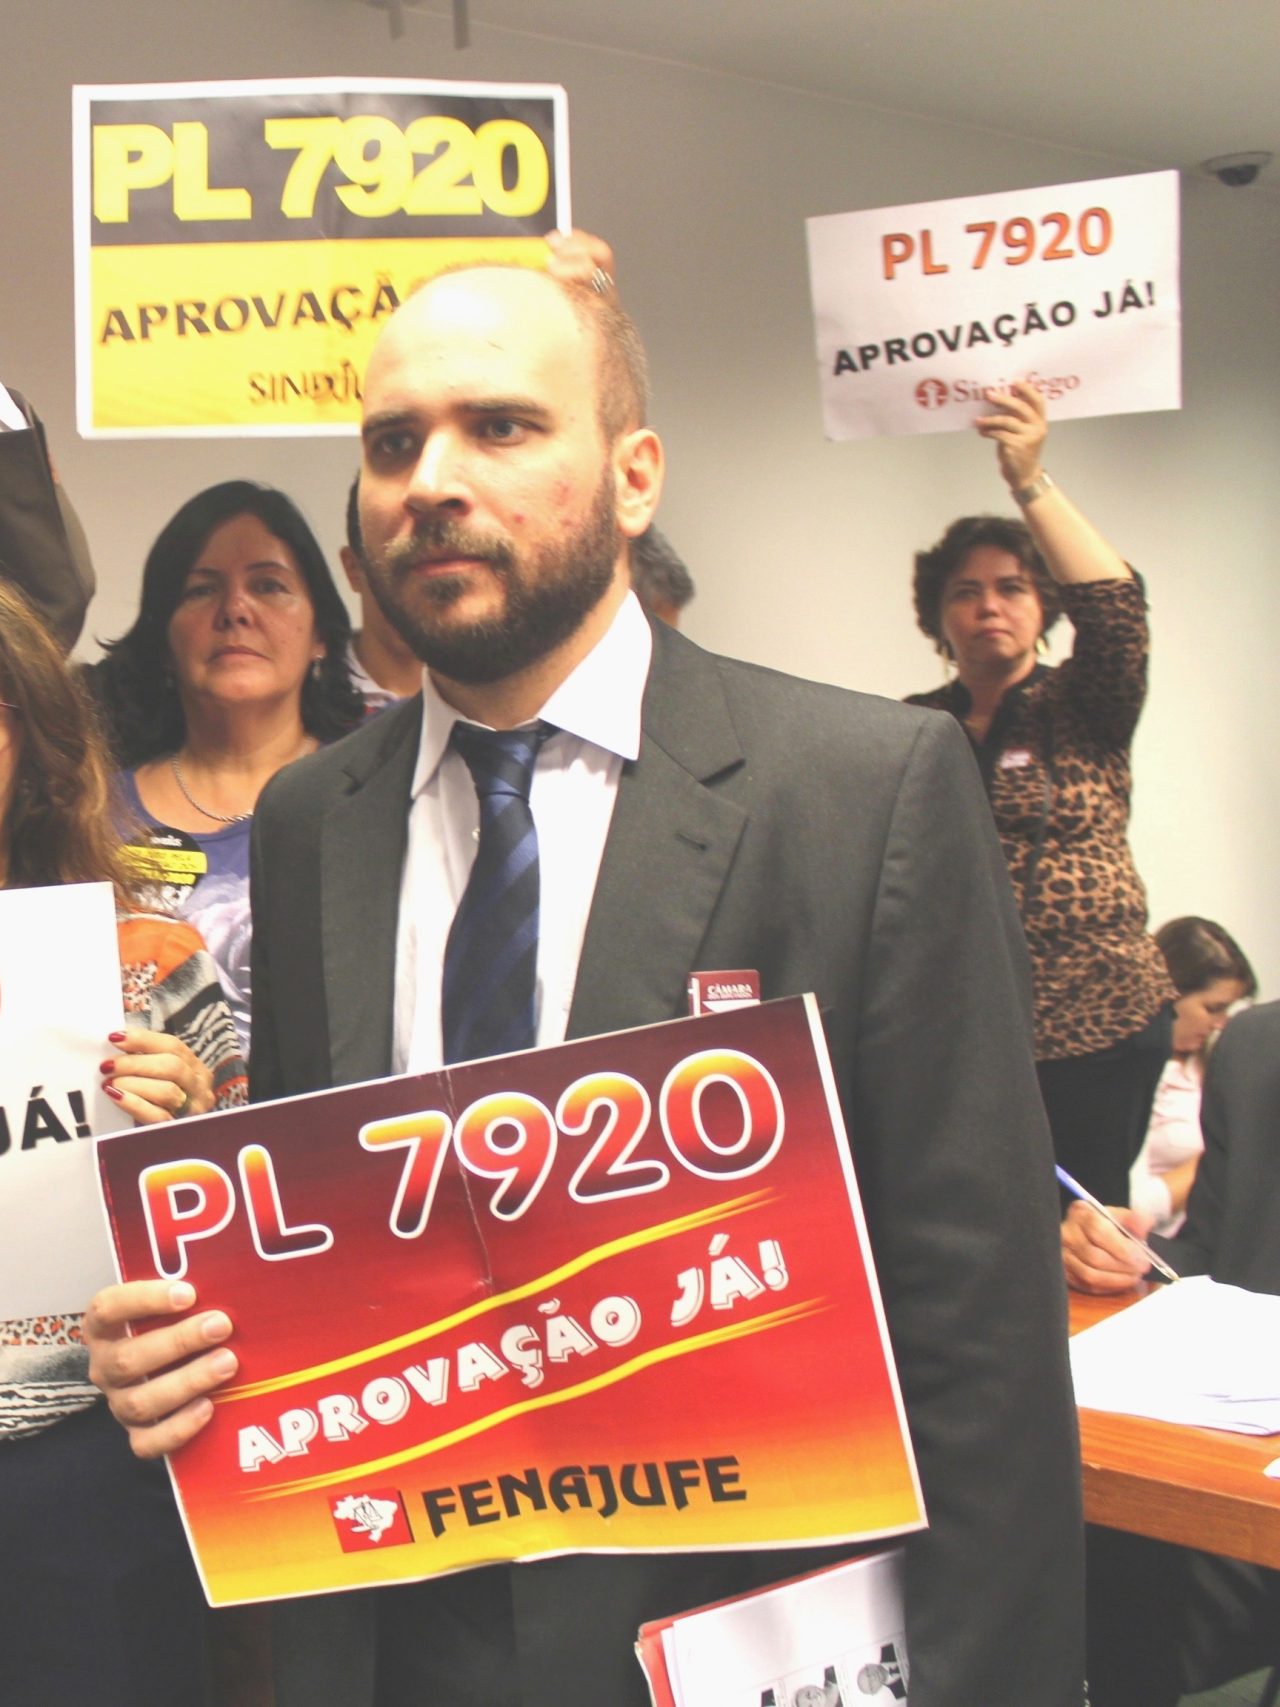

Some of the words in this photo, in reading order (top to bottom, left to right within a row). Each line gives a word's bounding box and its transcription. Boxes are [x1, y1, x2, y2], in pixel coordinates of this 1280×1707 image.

[93, 121, 252, 223] PL
[264, 115, 550, 218] 7920
[881, 229, 949, 280] PL
[964, 206, 1113, 270] 7920
[99, 271, 402, 345] APROVAÇÃ
[832, 300, 1076, 376] APROVAÇÃO
[1094, 280, 1156, 318] JÁ!
[138, 1144, 335, 1280] PL
[358, 1049, 786, 1239] 7920
[238, 1297, 640, 1472] APROVAÇÃO
[670, 1234, 788, 1326] JÁ!
[420, 1456, 748, 1539] FENAJUFE
